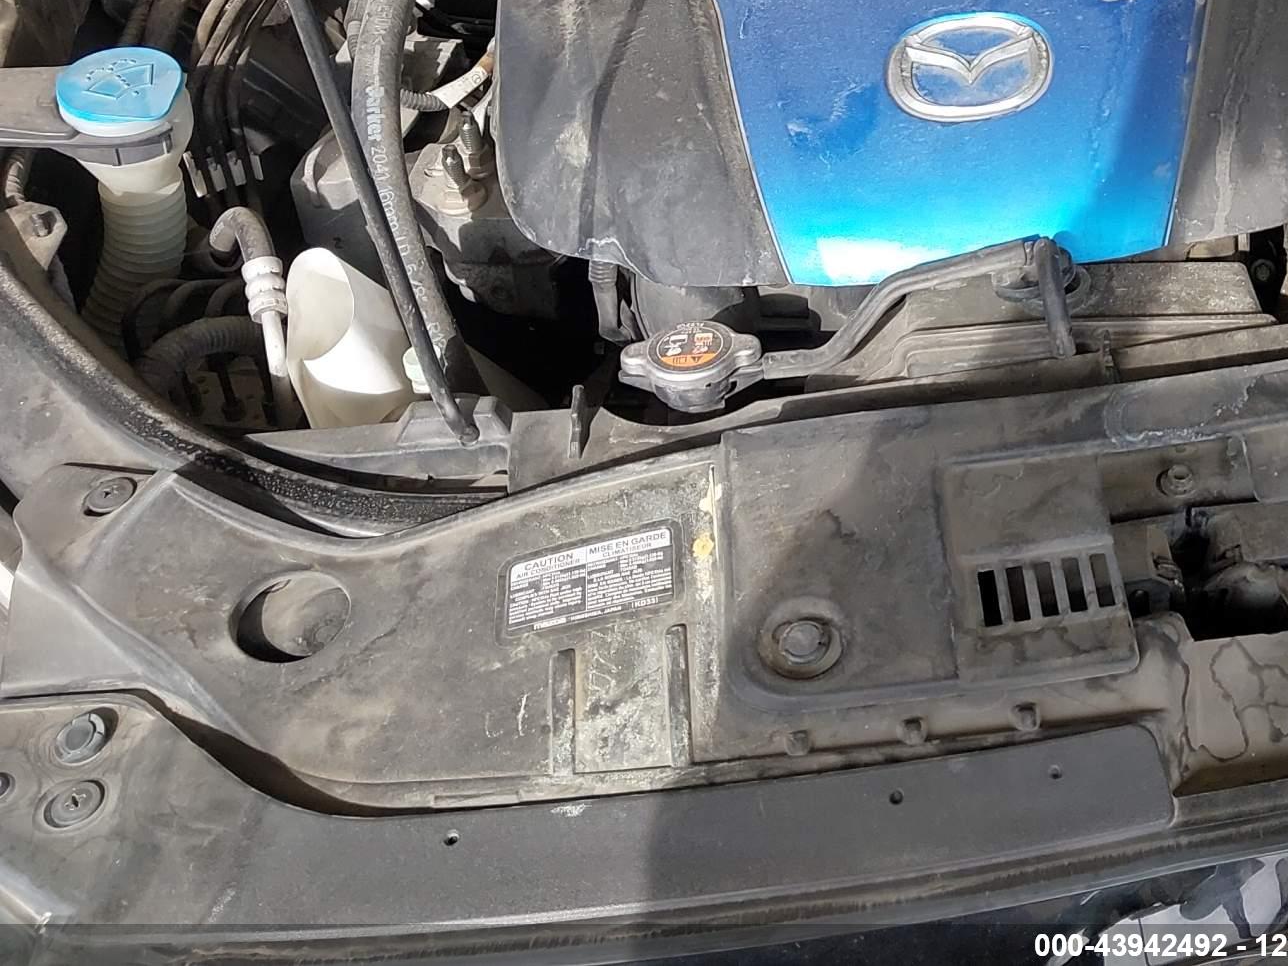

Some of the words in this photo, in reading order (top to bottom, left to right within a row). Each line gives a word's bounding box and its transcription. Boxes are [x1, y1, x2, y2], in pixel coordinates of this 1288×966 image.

[364, 86, 386, 141] Parker
[371, 145, 391, 181] 2041
[589, 542, 614, 555] MISE
[616, 539, 629, 549] EN
[631, 531, 667, 545] GARDE
[602, 542, 652, 557] CLIMATISEUR
[516, 571, 529, 579] AIR
[530, 558, 581, 576] CONDITIONER
[524, 552, 574, 571] CAUTION
